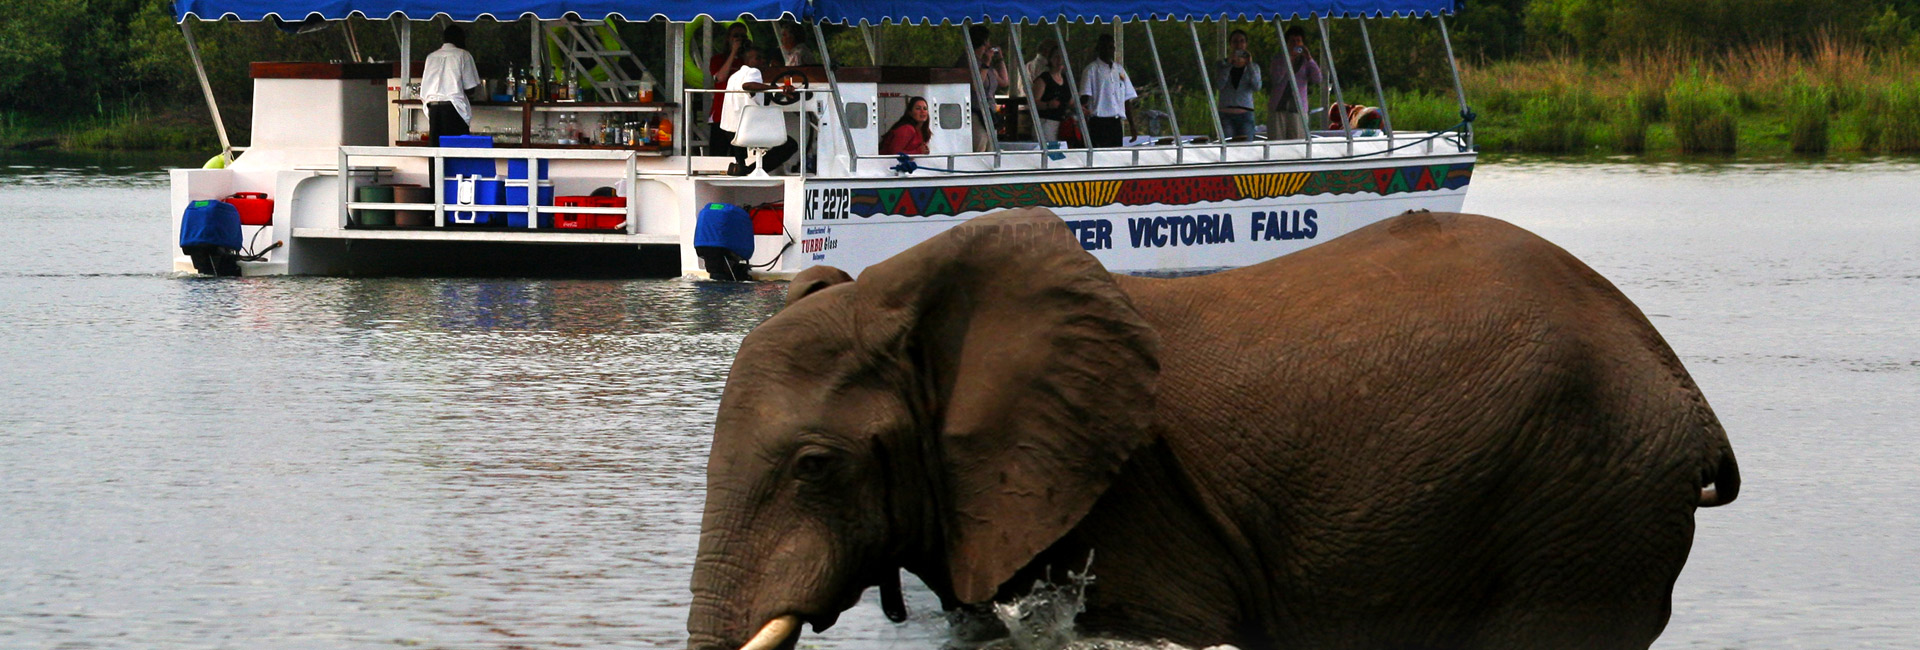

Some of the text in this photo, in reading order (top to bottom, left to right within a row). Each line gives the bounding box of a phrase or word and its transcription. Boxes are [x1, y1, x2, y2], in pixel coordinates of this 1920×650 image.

[804, 188, 849, 220] KF 2272
[1128, 213, 1235, 248] VICTORIA
[1250, 208, 1318, 241] FALLS
[801, 238, 823, 254] TURBO
